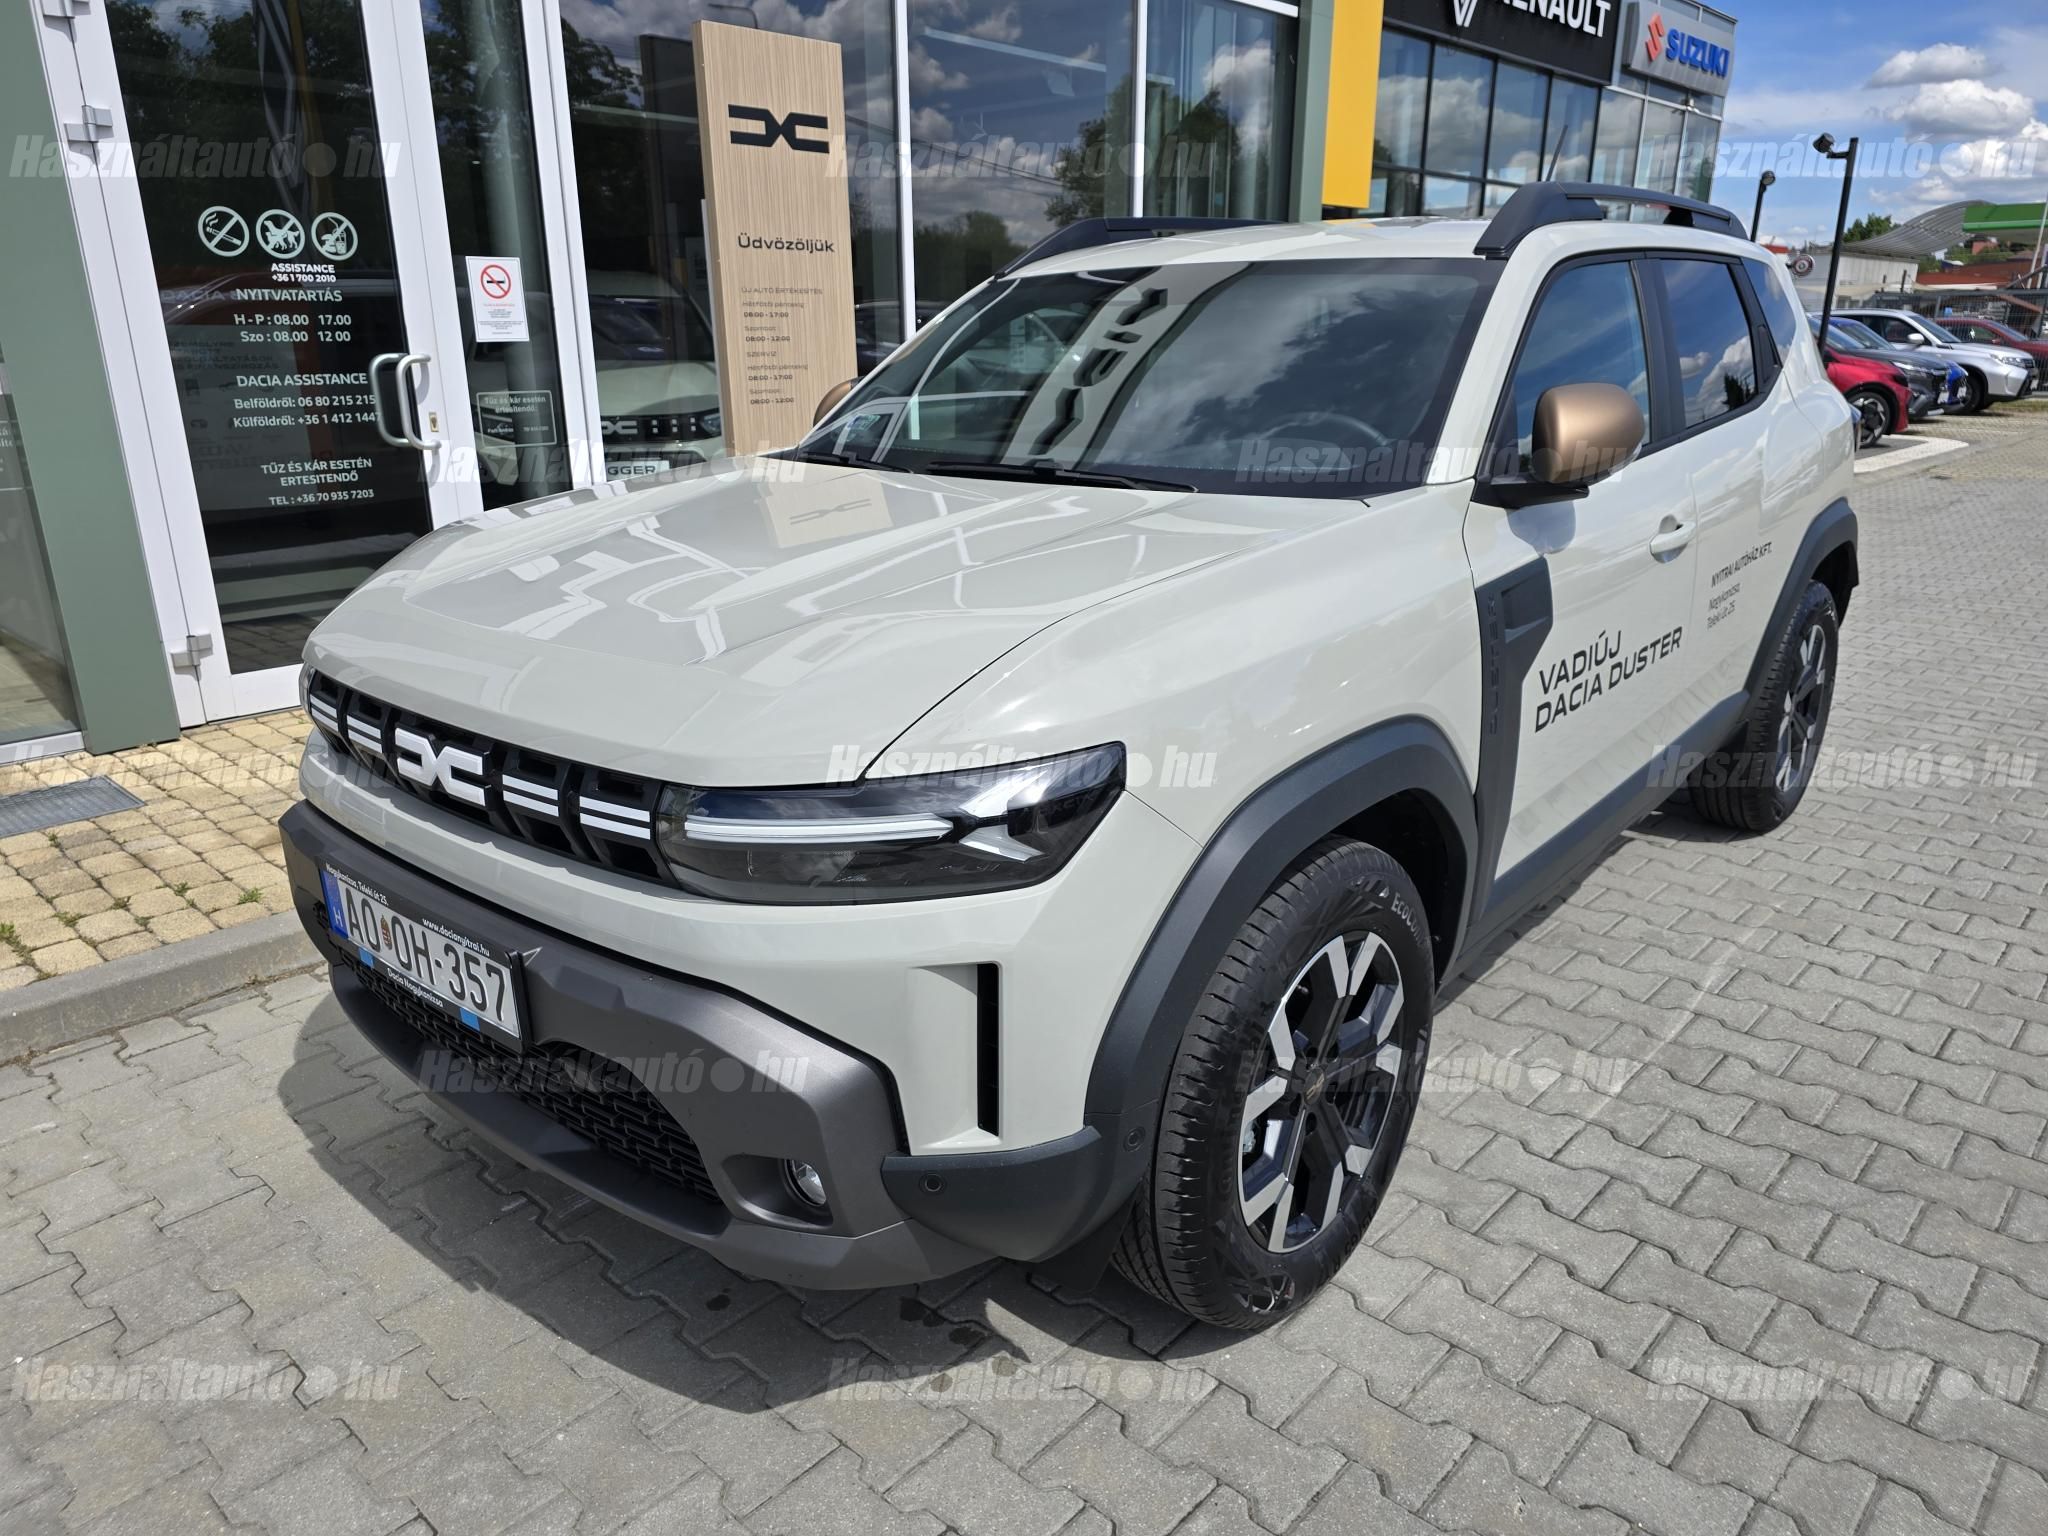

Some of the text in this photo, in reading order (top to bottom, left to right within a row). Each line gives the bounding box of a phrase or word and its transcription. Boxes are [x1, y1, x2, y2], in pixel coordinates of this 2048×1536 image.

[1666, 28, 1730, 78] SUZUKI
[738, 232, 835, 254] Üdvözöljük
[271, 263, 336, 273] ASSISTANCE
[271, 273, 289, 282] +36
[295, 274, 314, 282] 700
[315, 274, 337, 283] 2010
[236, 287, 343, 302] NYITVATARTÁS
[234, 314, 246, 326] H
[273, 314, 310, 326] 08.00
[318, 314, 352, 326] 17.00
[240, 331, 265, 343] Szo
[273, 331, 309, 343] 08.00
[236, 372, 369, 388] DACIA ASSISTANCE
[234, 394, 377, 409] Belföldről: 06 80 215 215
[233, 415, 296, 428] Külföldről:
[297, 414, 320, 426] +36
[322, 413, 329, 424] 1
[331, 413, 353, 424] 412
[261, 461, 286, 475] TŰZ
[287, 460, 303, 473] ÉS
[304, 458, 328, 471] KÁR
[329, 457, 373, 470] ESETÉN
[280, 469, 359, 487] ERTESITENDŐ
[268, 496, 290, 506] TEL
[296, 493, 316, 504] +36
[317, 492, 330, 502] 70
[331, 491, 350, 502] 935
[350, 488, 375, 500] 7203
[1539, 630, 1622, 695] VADIÚJ
[1534, 626, 1683, 733] DACIA DUSTER
[422, 918, 490, 957] www.dacianyitrai.hu
[404, 978, 444, 1008] Nagykanizsa
